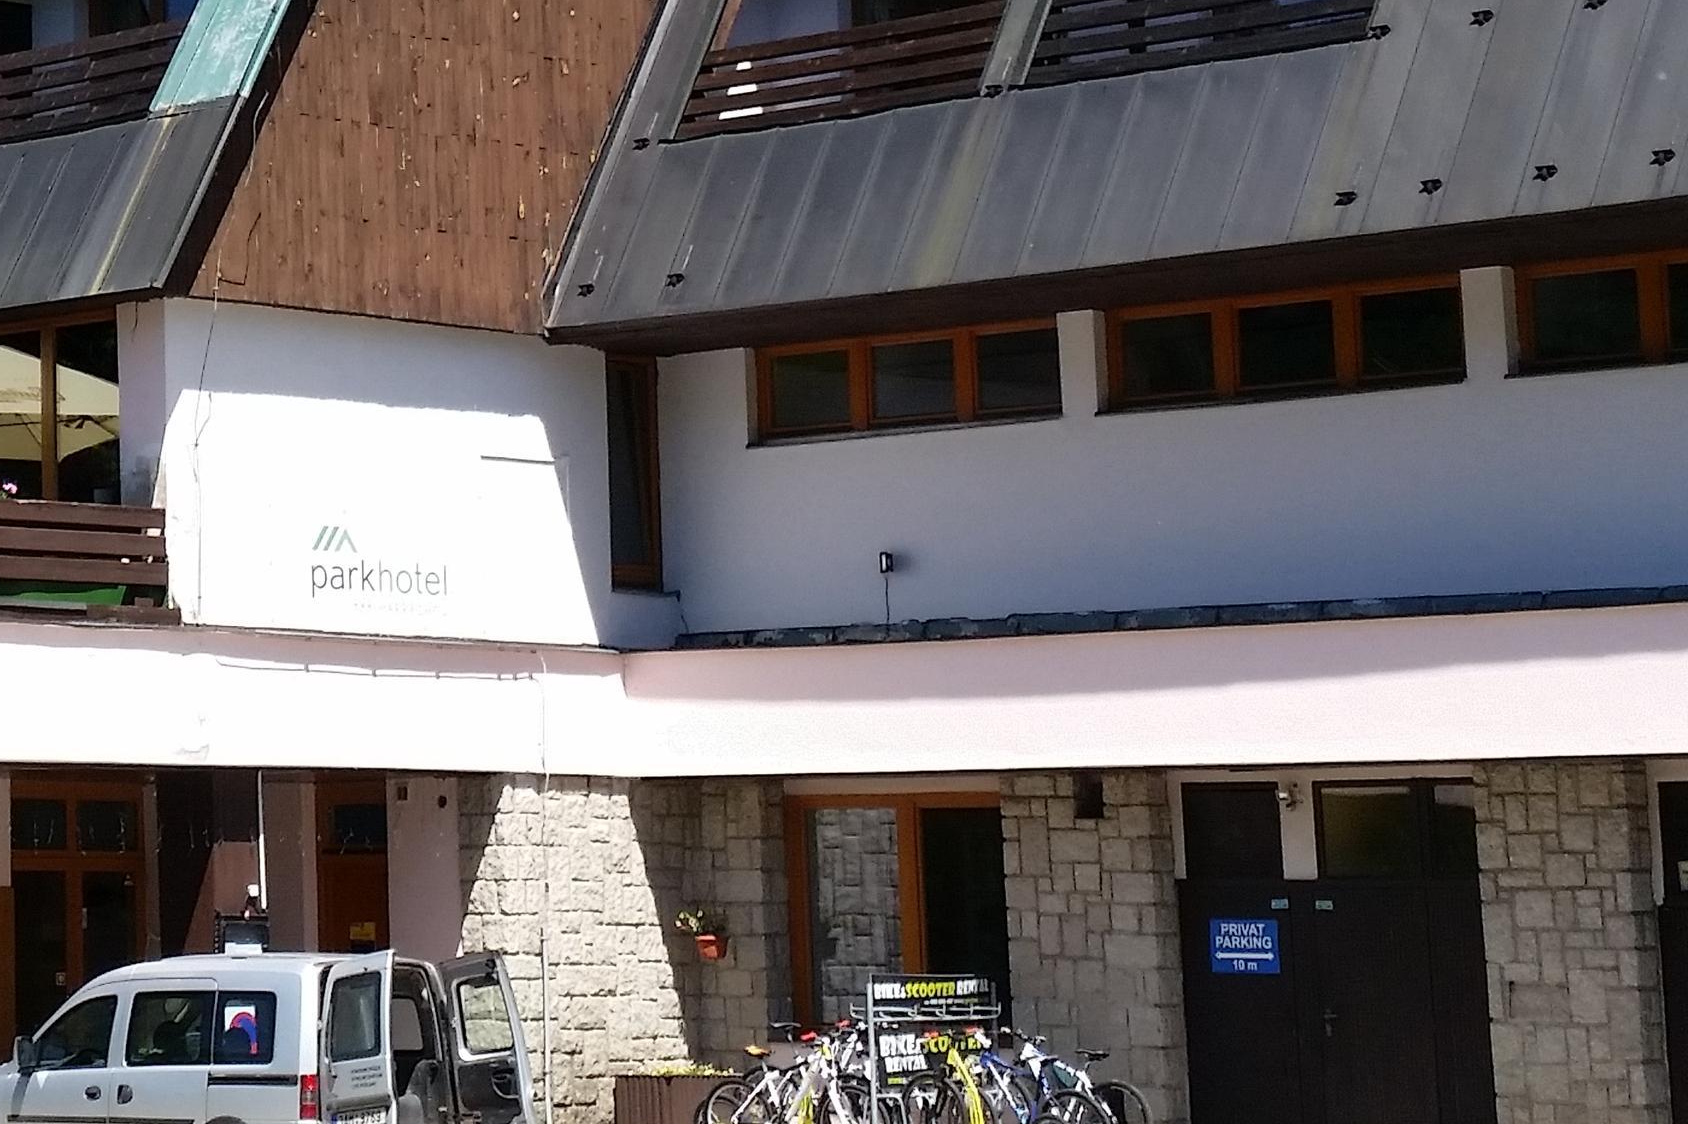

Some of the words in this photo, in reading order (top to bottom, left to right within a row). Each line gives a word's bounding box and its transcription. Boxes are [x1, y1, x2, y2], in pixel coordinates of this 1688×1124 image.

[312, 560, 447, 598] parkhotel
[1220, 923, 1265, 936] PRIVAT
[1215, 936, 1272, 949] PARKING
[1233, 959, 1245, 970] 10
[1247, 961, 1258, 971] m
[956, 978, 989, 995] RENTAL
[884, 1054, 928, 1073] RENTAL
